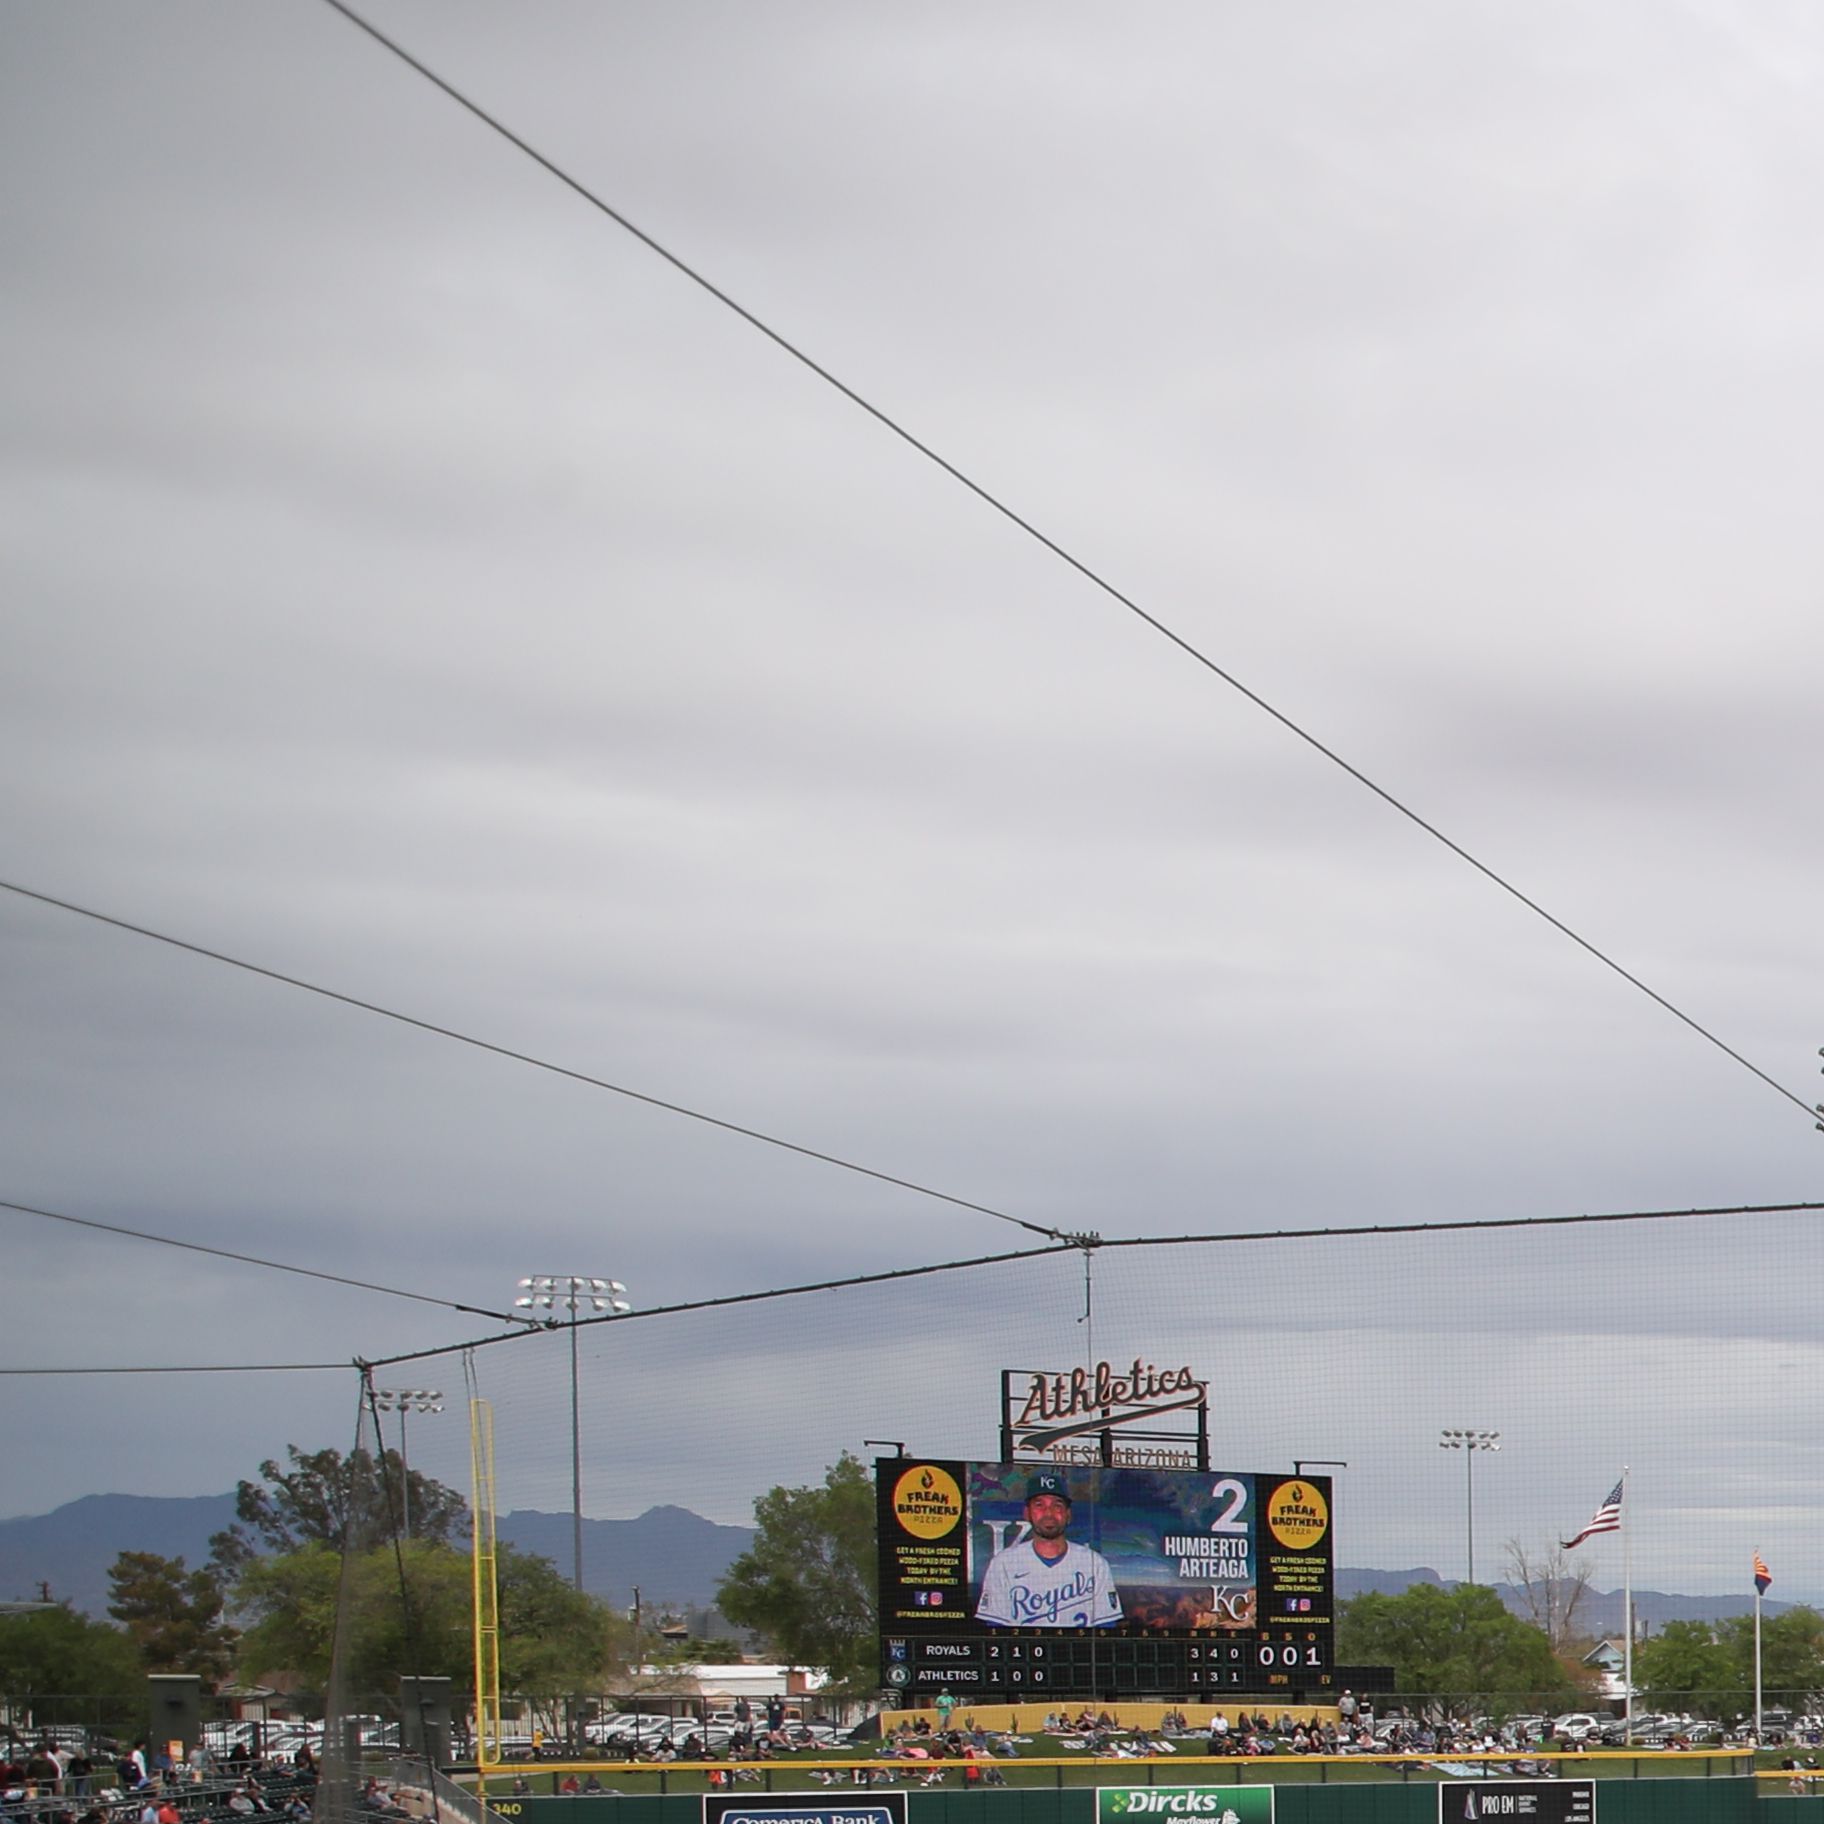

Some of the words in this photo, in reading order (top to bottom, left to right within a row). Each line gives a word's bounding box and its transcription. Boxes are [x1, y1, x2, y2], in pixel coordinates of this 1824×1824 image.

[1012, 1357, 1206, 1428] Athletics
[1053, 1444, 1103, 1464] MESA
[1112, 1447, 1192, 1469] ARIZONA
[907, 1490, 949, 1504] FREAK
[1211, 1479, 1249, 1533] 2
[897, 1504, 959, 1515] BROTHERS
[1280, 1505, 1316, 1517] FREAK
[914, 1515, 943, 1524] PIZZA
[1271, 1517, 1324, 1527] BROTHERS
[1165, 1536, 1249, 1558] HUMBERTO
[1179, 1558, 1249, 1578] ARTEAGA
[1009, 1571, 1096, 1624] Royals
[1210, 1584, 1249, 1622] KC
[926, 1645, 971, 1656] ROYALS
[991, 1647, 999, 1657] 2
[1013, 1647, 1021, 1657] 1
[1034, 1647, 1043, 1657] 0
[1190, 1648, 1199, 1658] 3
[1209, 1648, 1218, 1658] 4
[1230, 1649, 1239, 1658] 0
[1259, 1647, 1274, 1665] 0
[1282, 1647, 1298, 1665] 0
[1306, 1647, 1321, 1665] 1
[918, 1671, 979, 1681] ATHLETICS
[991, 1672, 999, 1682] 1
[1013, 1672, 1021, 1682] 0
[1035, 1672, 1043, 1682] 0
[1192, 1672, 1199, 1682] 1
[1210, 1672, 1219, 1682] 3
[1231, 1672, 1239, 1682] 1
[1127, 1790, 1218, 1813] Dircks
[1482, 1795, 1500, 1814] PRO
